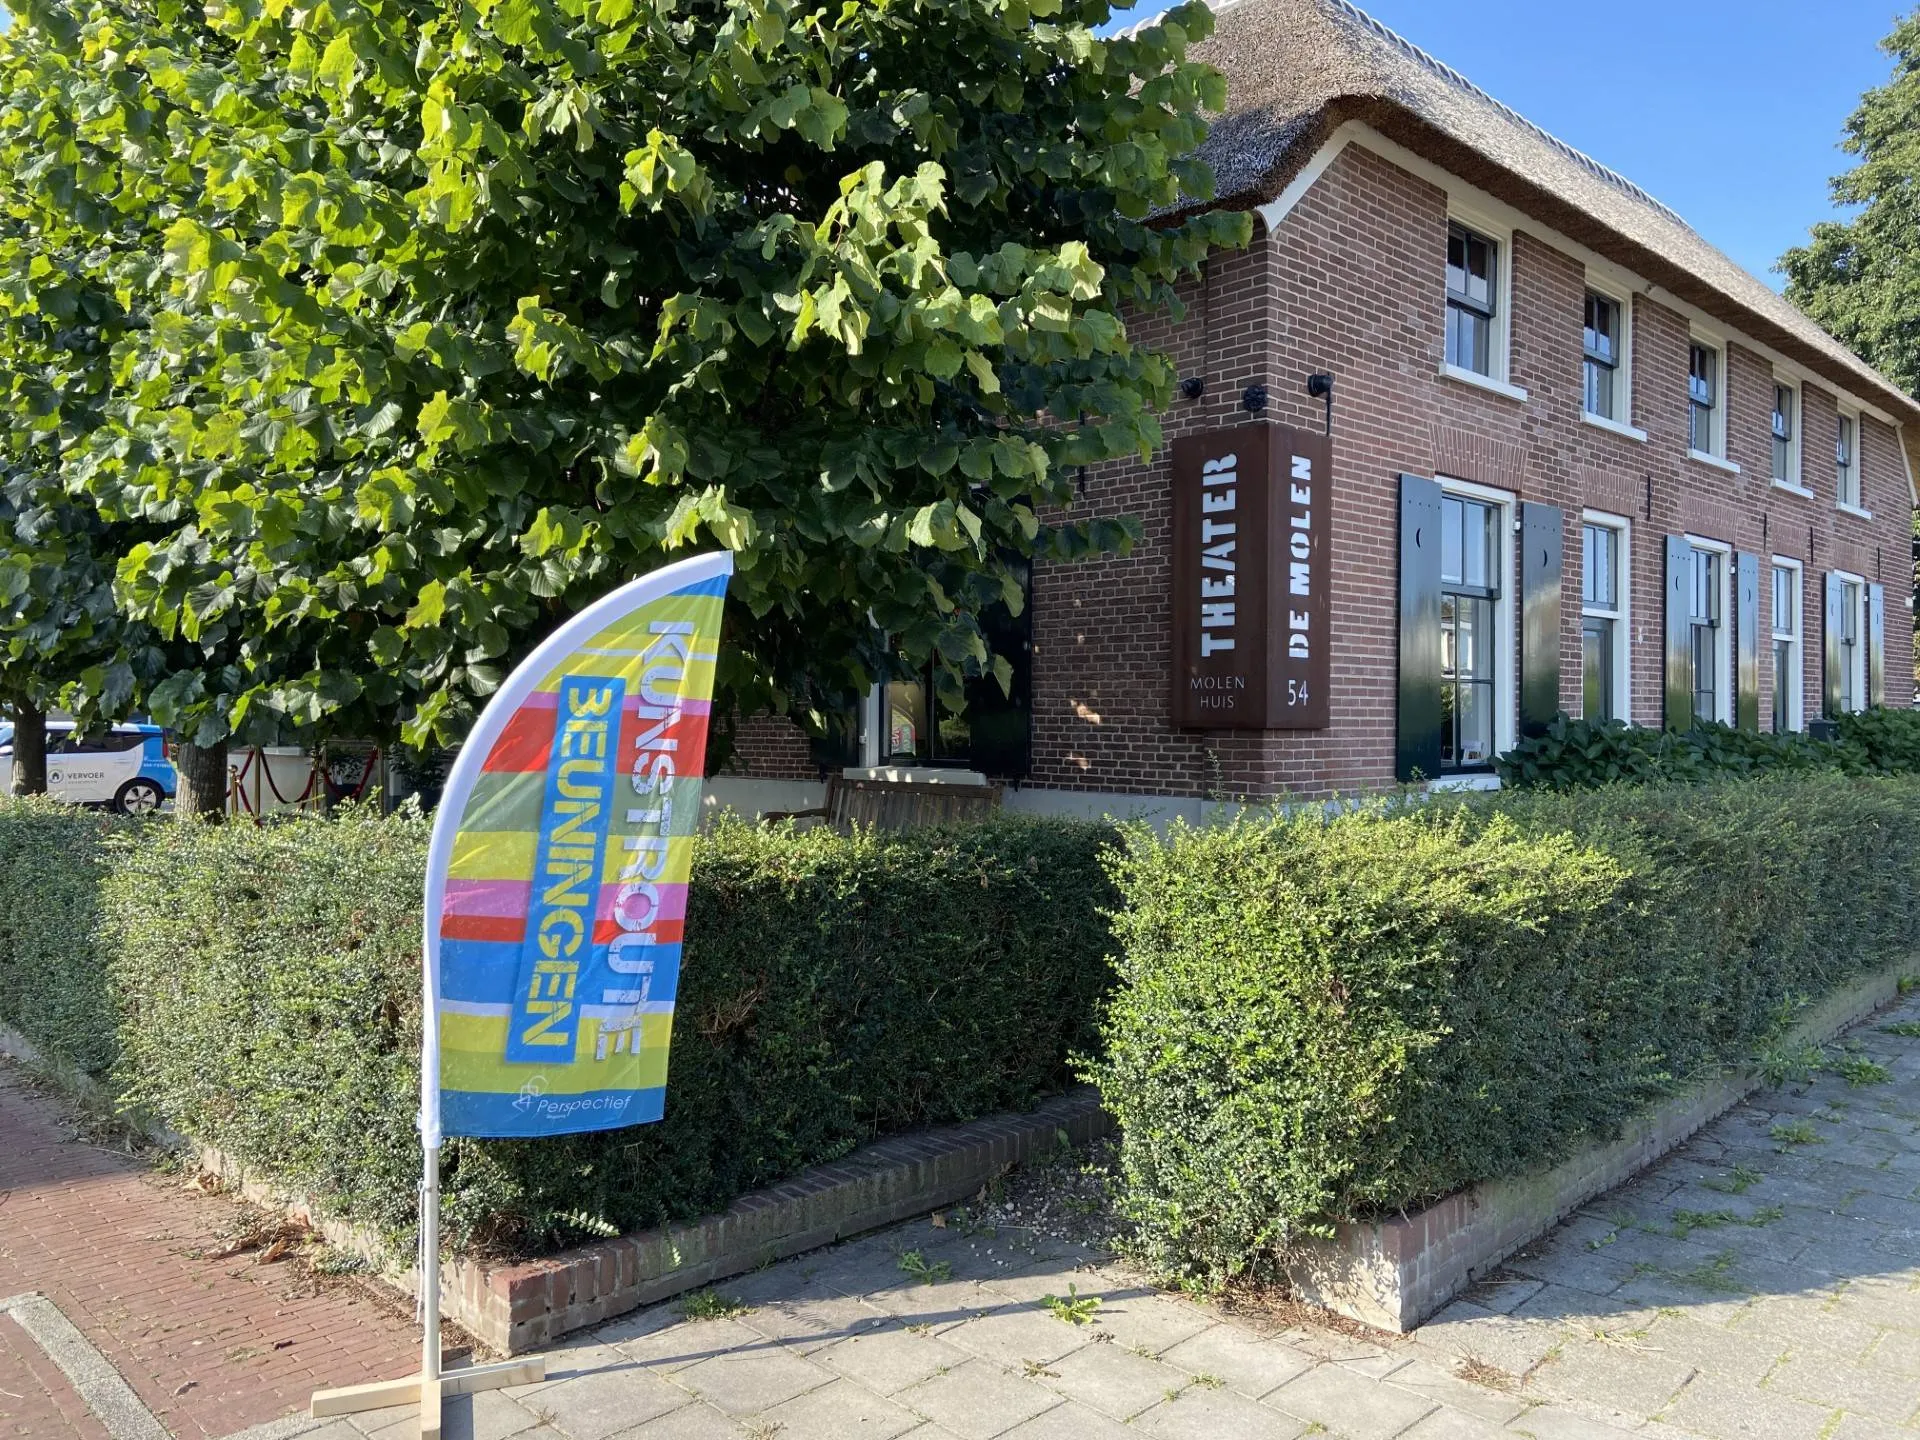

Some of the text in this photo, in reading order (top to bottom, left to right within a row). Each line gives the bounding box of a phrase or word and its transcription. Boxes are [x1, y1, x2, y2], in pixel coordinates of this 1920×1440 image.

[1201, 453, 1238, 657] THEATER
[1289, 455, 1312, 659] DE MOLEN
[1190, 676, 1245, 690] MOLEN
[1288, 679, 1309, 706] 54
[1200, 695, 1235, 709] HUIS
[67, 771, 104, 779] VERVOER
[595, 621, 695, 1061] KUNSTROUTE
[537, 1095, 632, 1117] Perspectief
